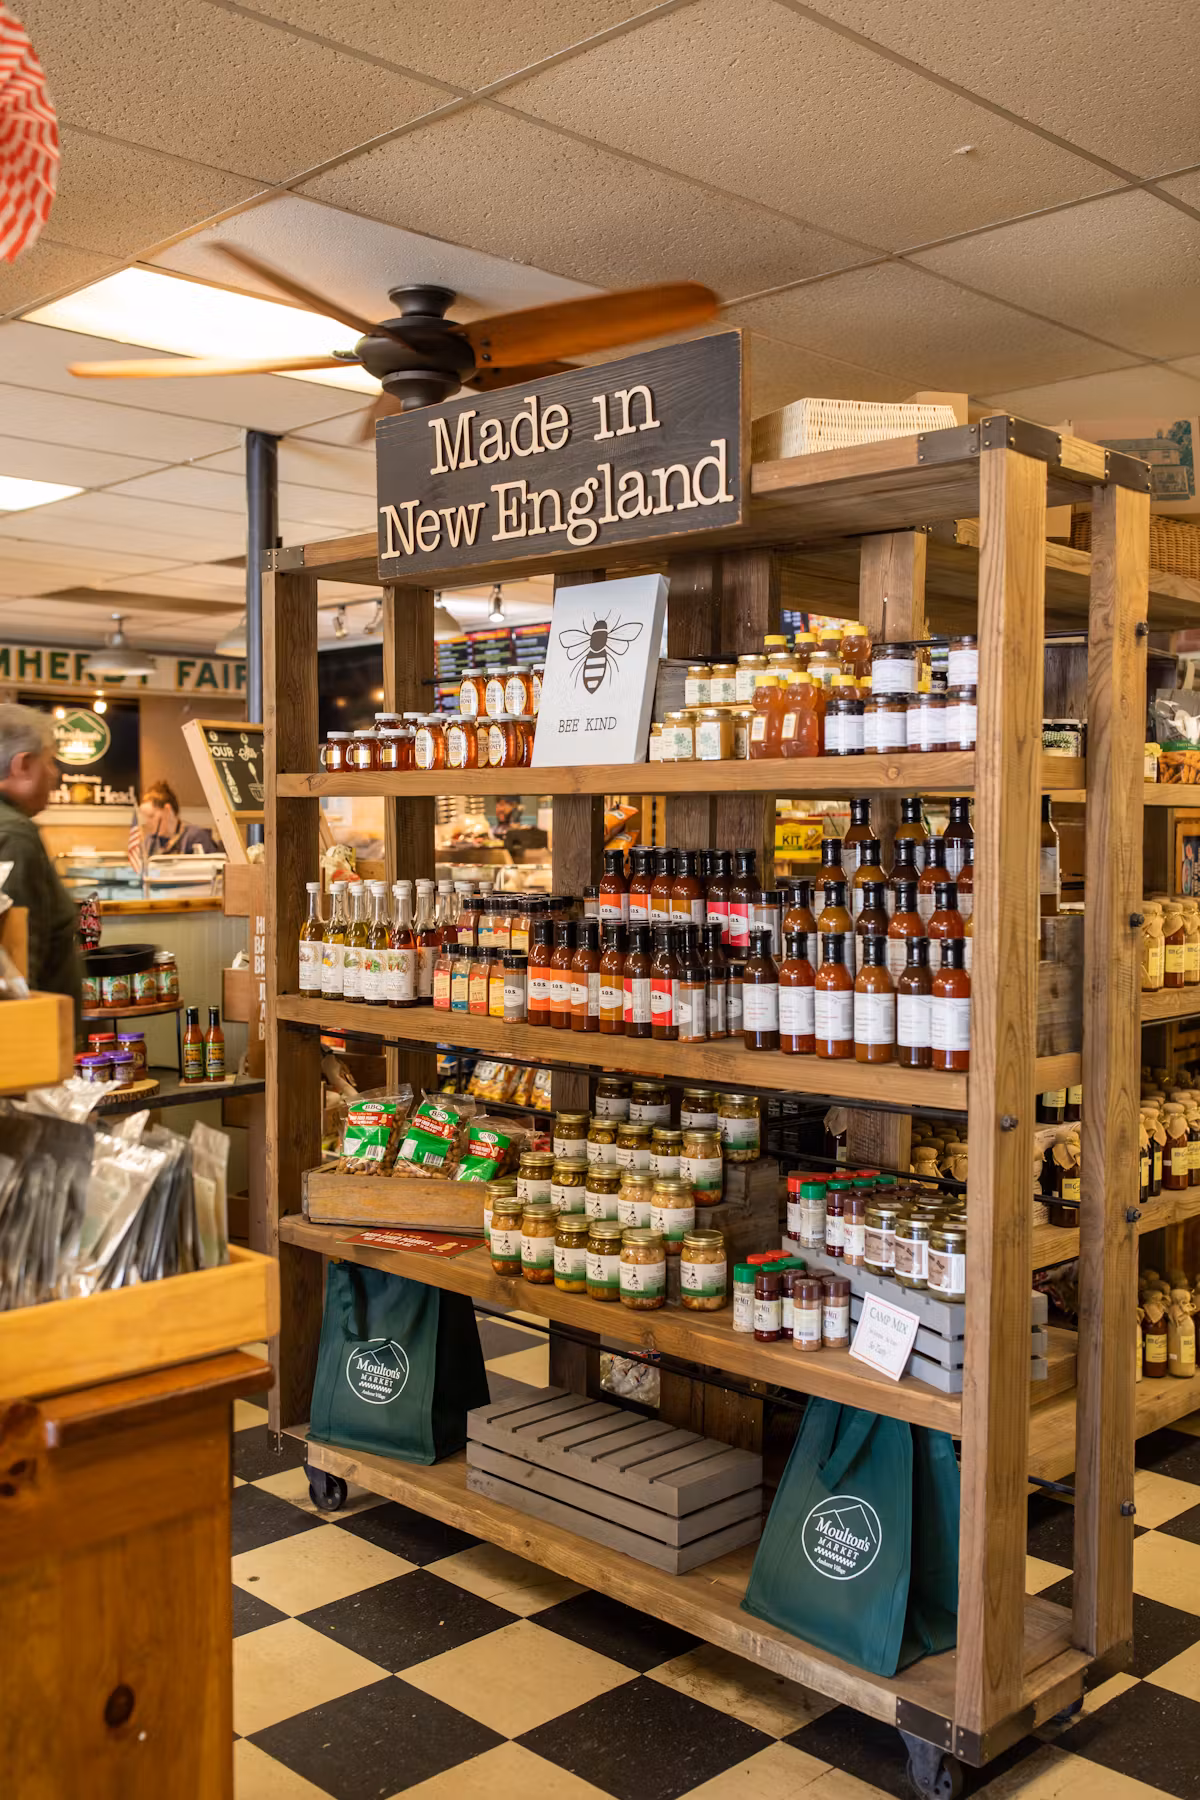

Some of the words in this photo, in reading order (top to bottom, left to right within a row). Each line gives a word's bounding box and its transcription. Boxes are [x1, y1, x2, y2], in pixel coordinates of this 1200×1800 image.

[428, 395, 570, 475] Made
[592, 384, 660, 441] in
[379, 499, 486, 559] New
[490, 438, 734, 546] England
[558, 718, 580, 733] BEE
[584, 716, 617, 731] KIND
[782, 835, 801, 845] KIT
[431, 1110, 447, 1120] BBQ
[869, 1307, 891, 1326] CAMP
[892, 1317, 909, 1335] MIX
[356, 1358, 400, 1380] Moulton's
[361, 1373, 394, 1387] MARKET
[815, 1516, 870, 1552] Moulton's
[818, 1537, 859, 1560] MARKET
